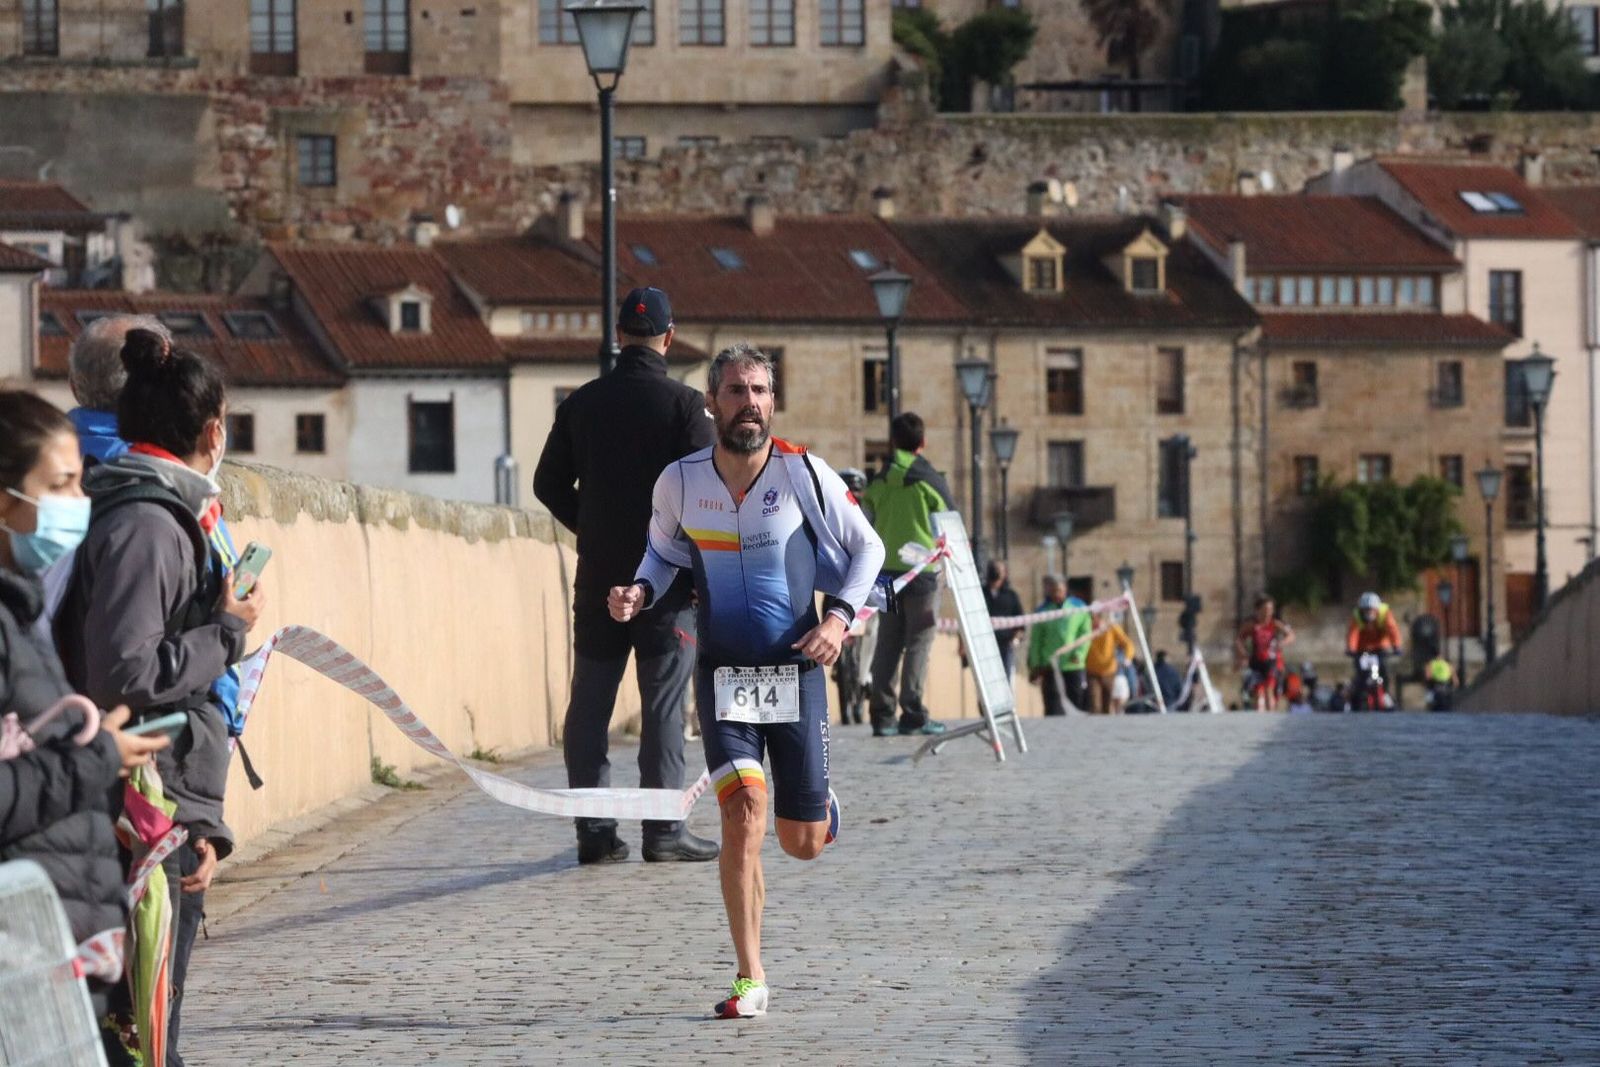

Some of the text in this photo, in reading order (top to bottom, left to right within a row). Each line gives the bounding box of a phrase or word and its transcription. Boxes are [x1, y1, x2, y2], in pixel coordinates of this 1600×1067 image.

[742, 531, 771, 543] UNIVEST
[733, 686, 779, 708] 614
[820, 719, 830, 780] UNIVEST
